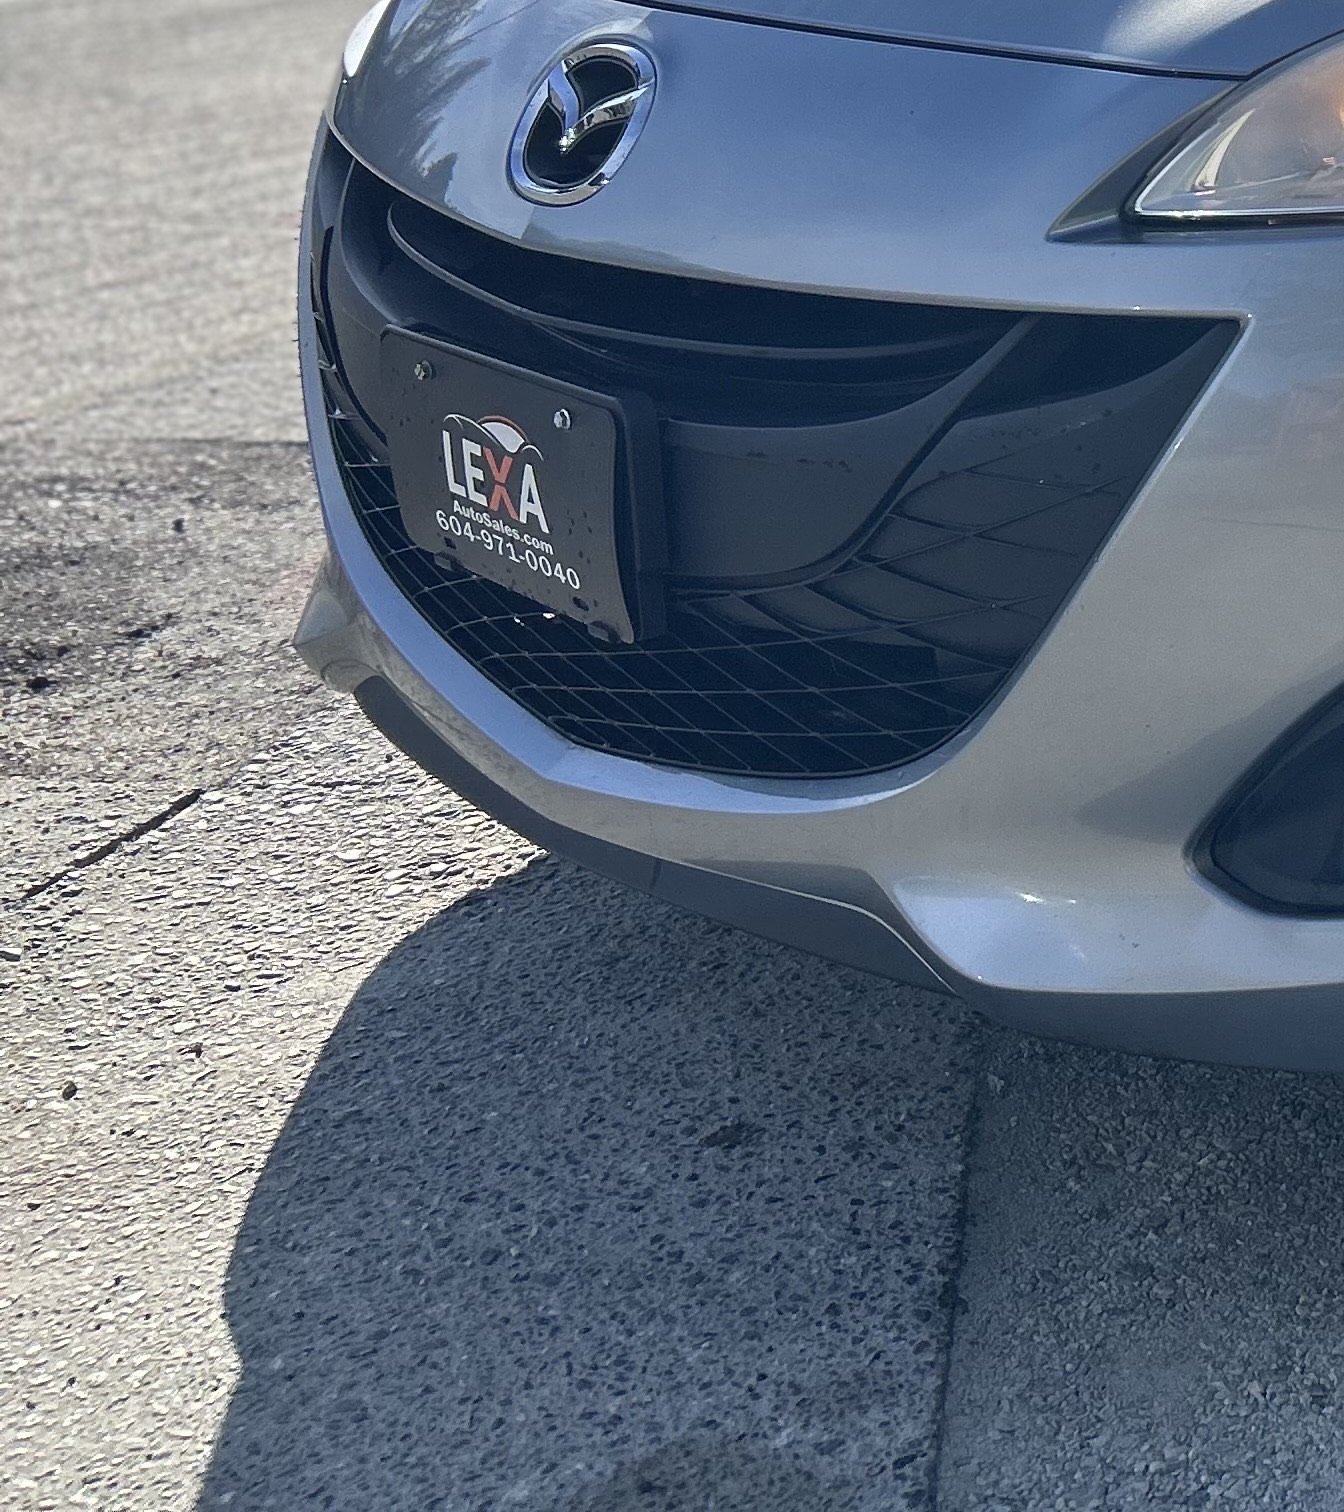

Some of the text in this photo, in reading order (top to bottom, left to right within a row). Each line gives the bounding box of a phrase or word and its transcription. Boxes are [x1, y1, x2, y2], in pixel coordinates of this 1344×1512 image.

[442, 429, 551, 534] LEXA
[435, 509, 582, 590] 604-971-0040
[453, 499, 555, 556] AutoSales.com
